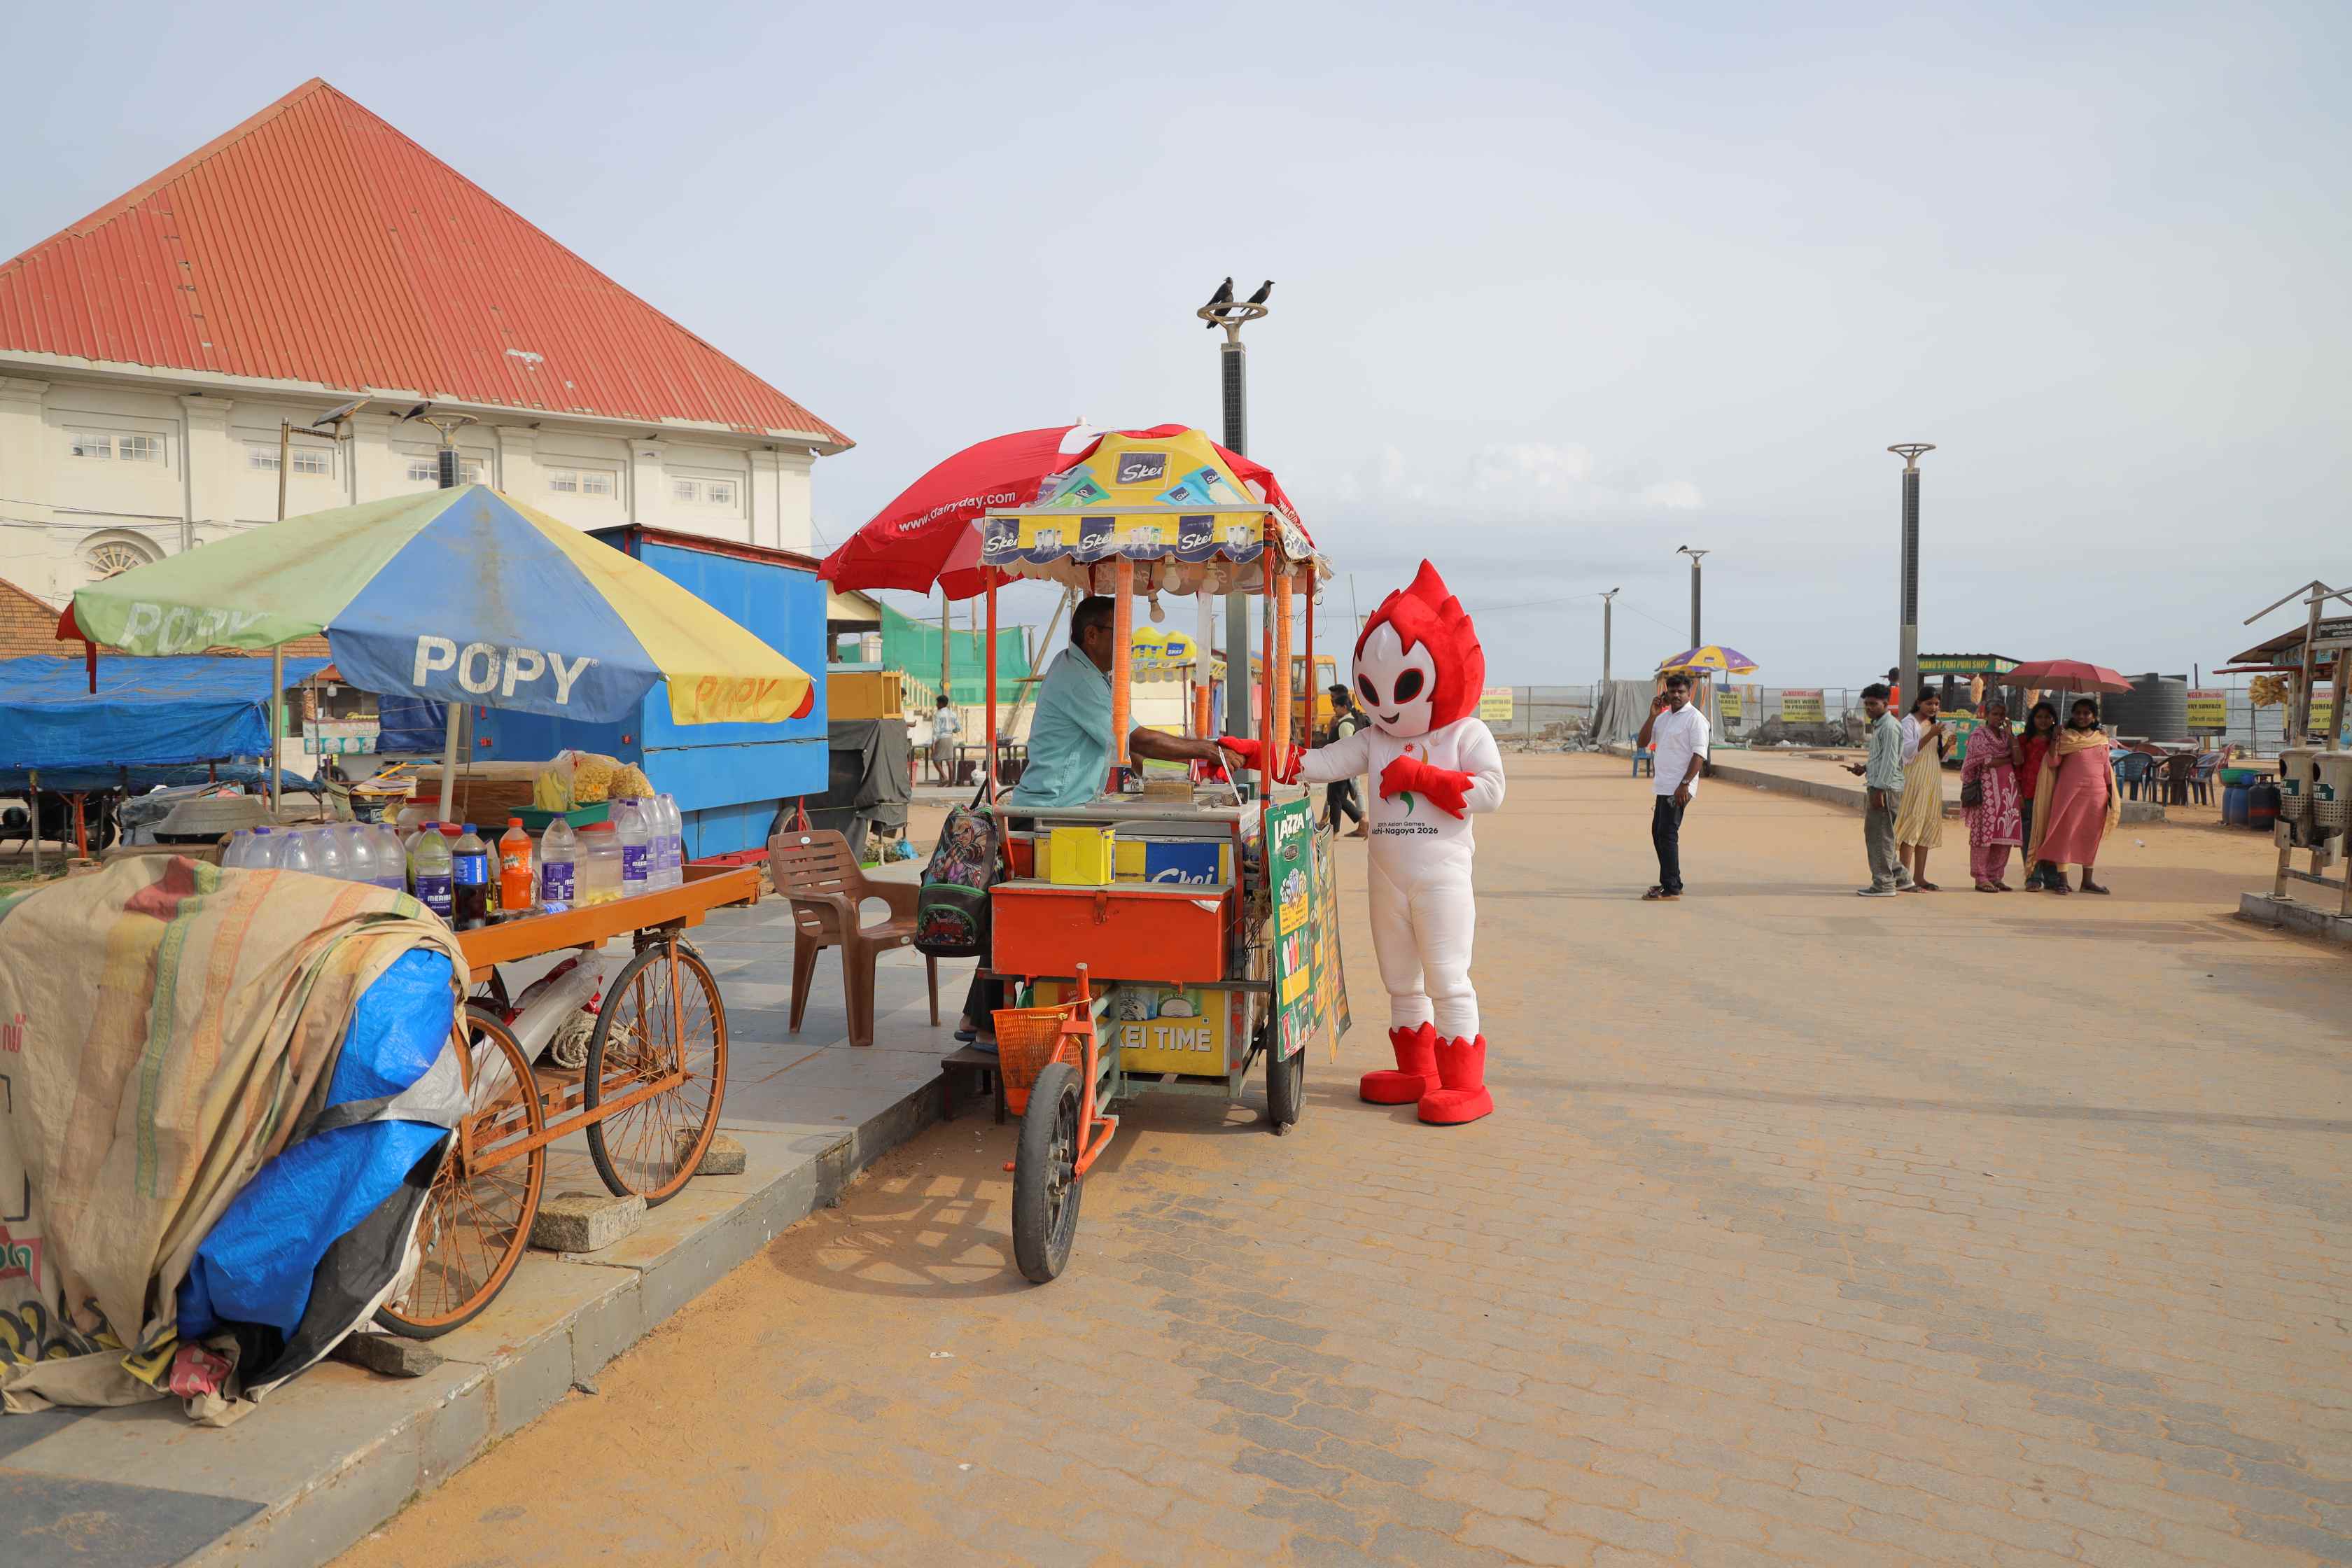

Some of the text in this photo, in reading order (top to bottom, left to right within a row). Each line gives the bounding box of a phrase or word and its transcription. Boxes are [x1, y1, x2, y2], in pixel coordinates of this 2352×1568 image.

[1121, 461, 1164, 482] Skei
[899, 492, 1016, 532] www.dairyday.com
[1082, 533, 1114, 552] Ske
[1181, 531, 1214, 550] Skei
[1274, 813, 1305, 853] LAZZA
[1154, 1026, 1212, 1052] TIME
